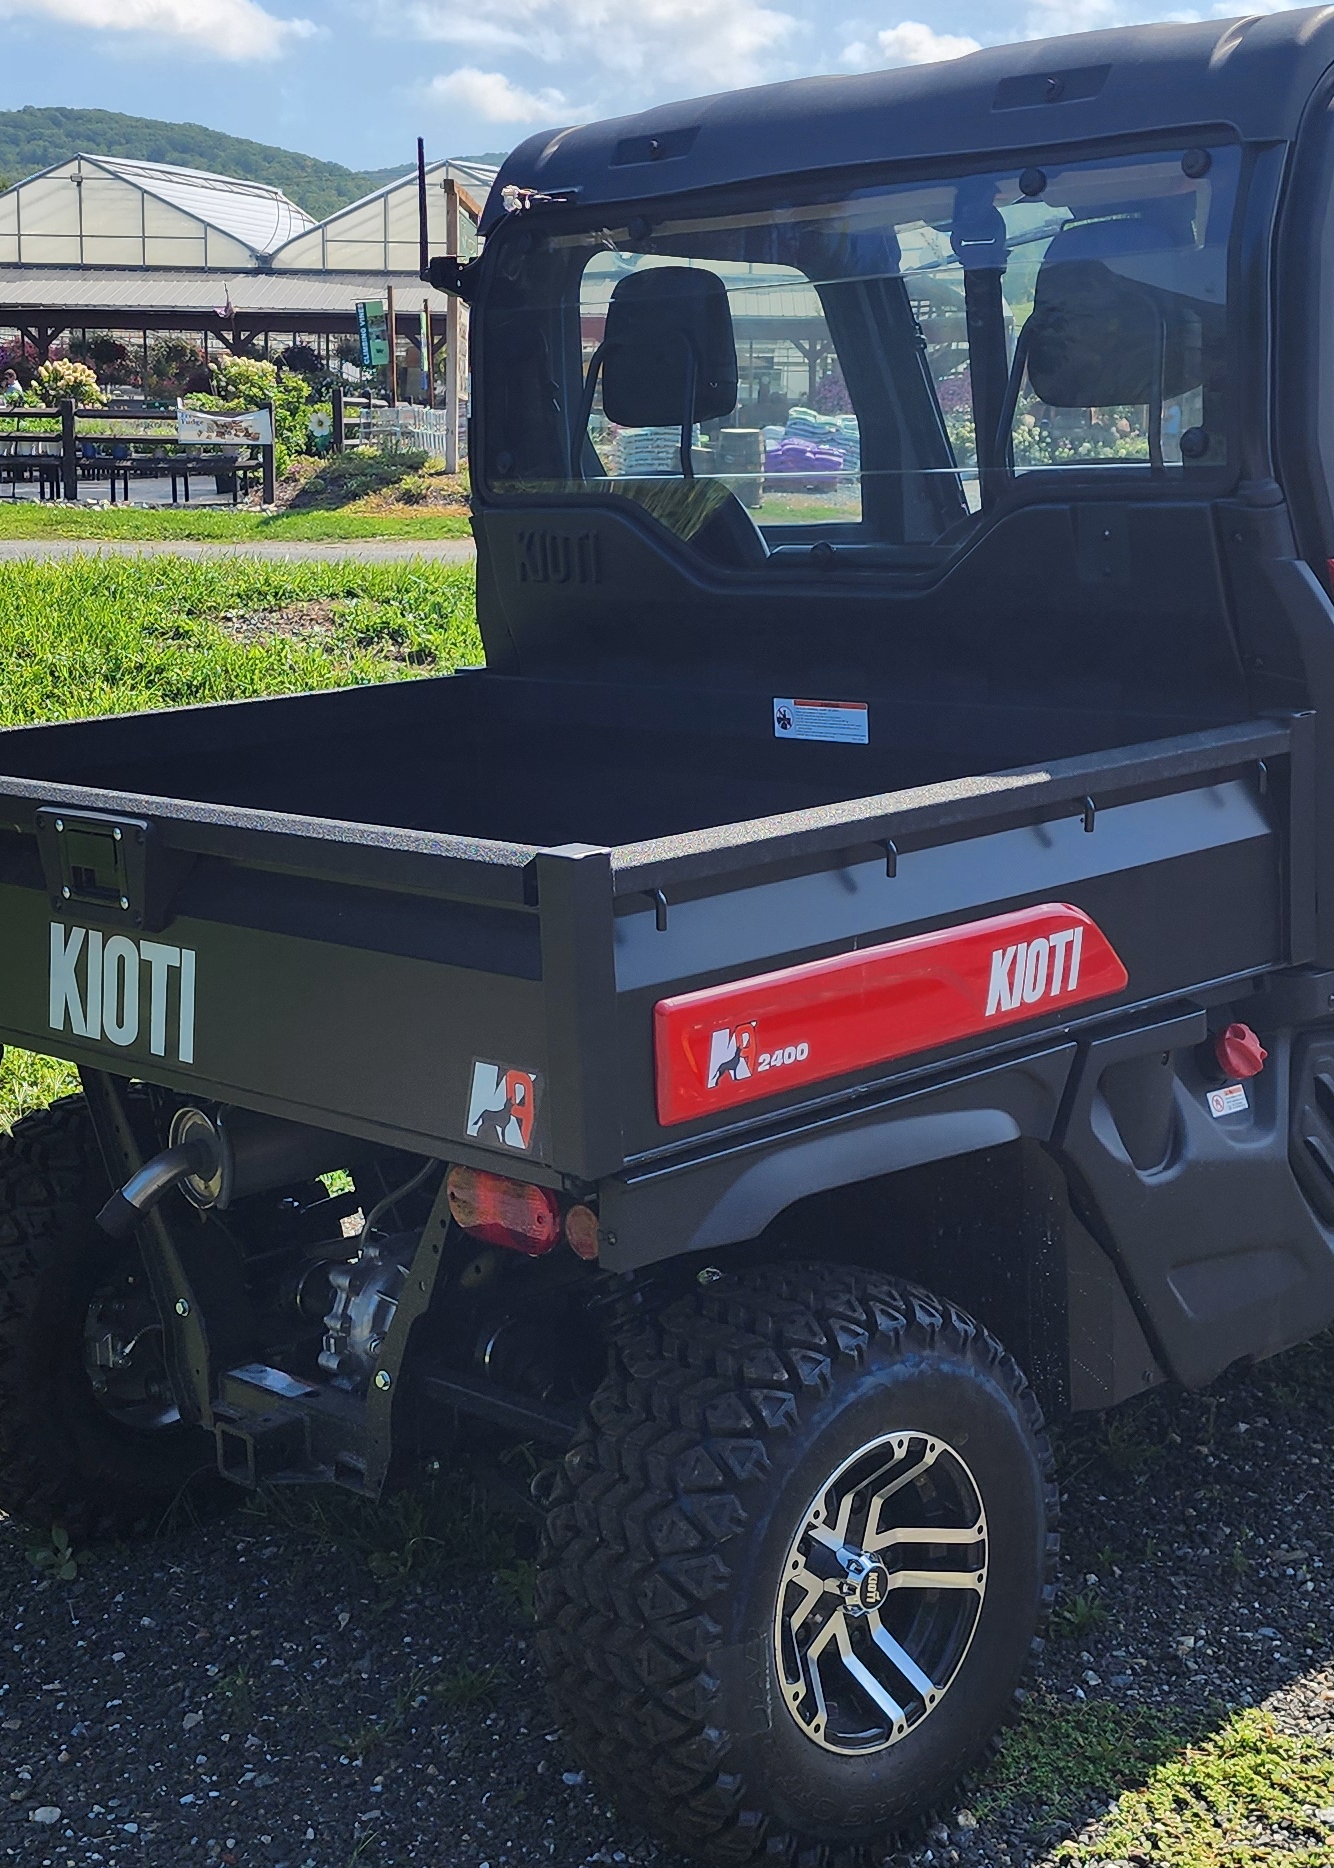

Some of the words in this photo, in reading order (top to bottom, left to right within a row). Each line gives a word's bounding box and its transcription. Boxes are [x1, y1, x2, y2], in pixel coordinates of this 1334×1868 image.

[357, 303, 366, 327] VINES
[360, 327, 371, 365] CLIMBING
[515, 528, 602, 583] KIOTI
[985, 926, 1083, 1016] KIOTI
[49, 921, 196, 1064] KIOTI
[757, 1042, 809, 1072] 2400
[866, 1572, 881, 1603] KIOTI
